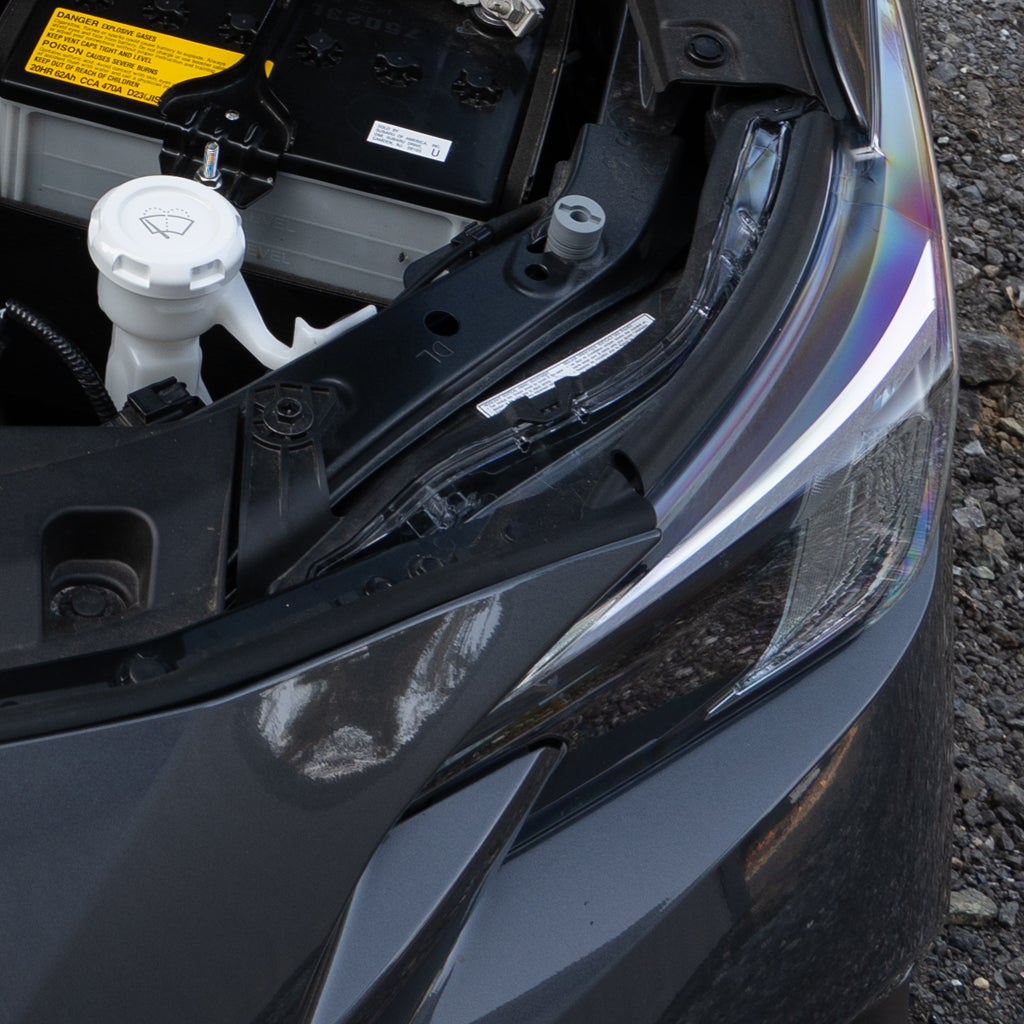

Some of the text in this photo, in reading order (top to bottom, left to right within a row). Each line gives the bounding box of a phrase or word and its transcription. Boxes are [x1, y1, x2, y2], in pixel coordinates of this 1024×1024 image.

[55, 11, 157, 42] DANGER EXPLOSIVE GASES
[41, 39, 159, 74] POISON CAUSES SEVERE BURNS
[45, 32, 152, 63] KEEP VENT CAPS TIGHT AND LEVEL
[29, 63, 54, 75] 20HR
[53, 69, 77, 81] 62Ah
[78, 76, 100, 87] CCA
[100, 82, 123, 93] 470A
[33, 56, 50, 64] KEEP
[50, 60, 64, 68] OUT
[74, 66, 97, 76] REACH
[106, 75, 140, 87] CHILDREN
[430, 148, 440, 157] U
